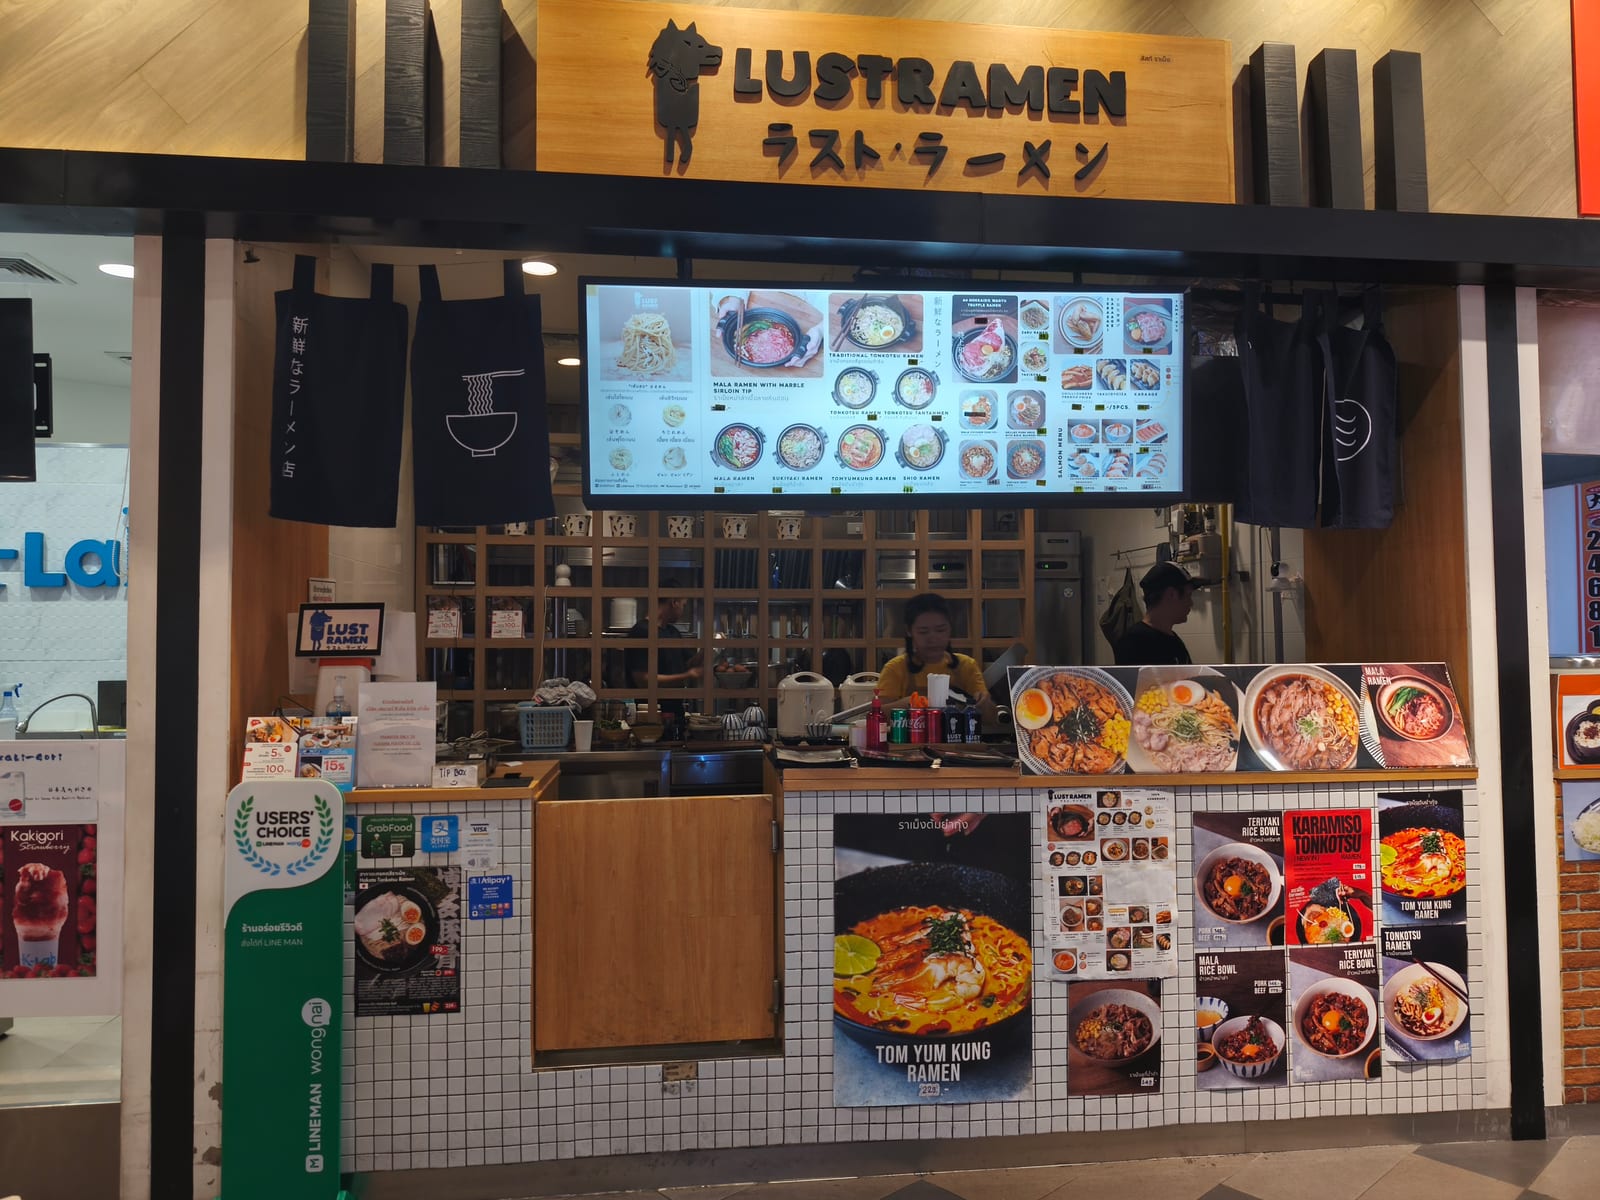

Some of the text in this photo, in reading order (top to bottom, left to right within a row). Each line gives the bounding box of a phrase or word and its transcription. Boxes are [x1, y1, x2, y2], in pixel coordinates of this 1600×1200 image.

[734, 47, 1127, 117] LUSTRAMEN
[282, 316, 309, 478] 新鮮なラーメン店
[327, 623, 369, 636] LUST
[326, 636, 369, 645] RAMEN
[1364, 667, 1385, 676] MALA
[1367, 677, 1392, 686] RAMEN
[256, 811, 314, 825] USERS'
[1248, 817, 1280, 827] TERIYAKI
[366, 823, 413, 833] GrabFood
[1292, 815, 1362, 834] KARAMISO
[10, 829, 64, 844] Kakigori
[256, 826, 310, 838] CHOICE
[1242, 826, 1281, 836] RICE BOWL
[19, 842, 70, 855] Strawberry
[1293, 834, 1361, 854] TONKOTSU
[1401, 900, 1452, 911] TOM YUM KUNG
[1415, 910, 1439, 919] RAMEN
[264, 937, 282, 947] LINE
[284, 936, 303, 946] MAN
[1385, 931, 1421, 941] TONKOTSU
[1385, 941, 1411, 951] RAMEN
[1199, 955, 1219, 965] MALA
[1344, 949, 1375, 960] TERIYAKI
[1199, 964, 1237, 975] RICE BOWL
[1339, 959, 1375, 970] RICE BOWL
[309, 1001, 327, 1075] wongnai
[876, 1041, 991, 1063] TOM YUM KUNG
[907, 1063, 960, 1082] RAMEN
